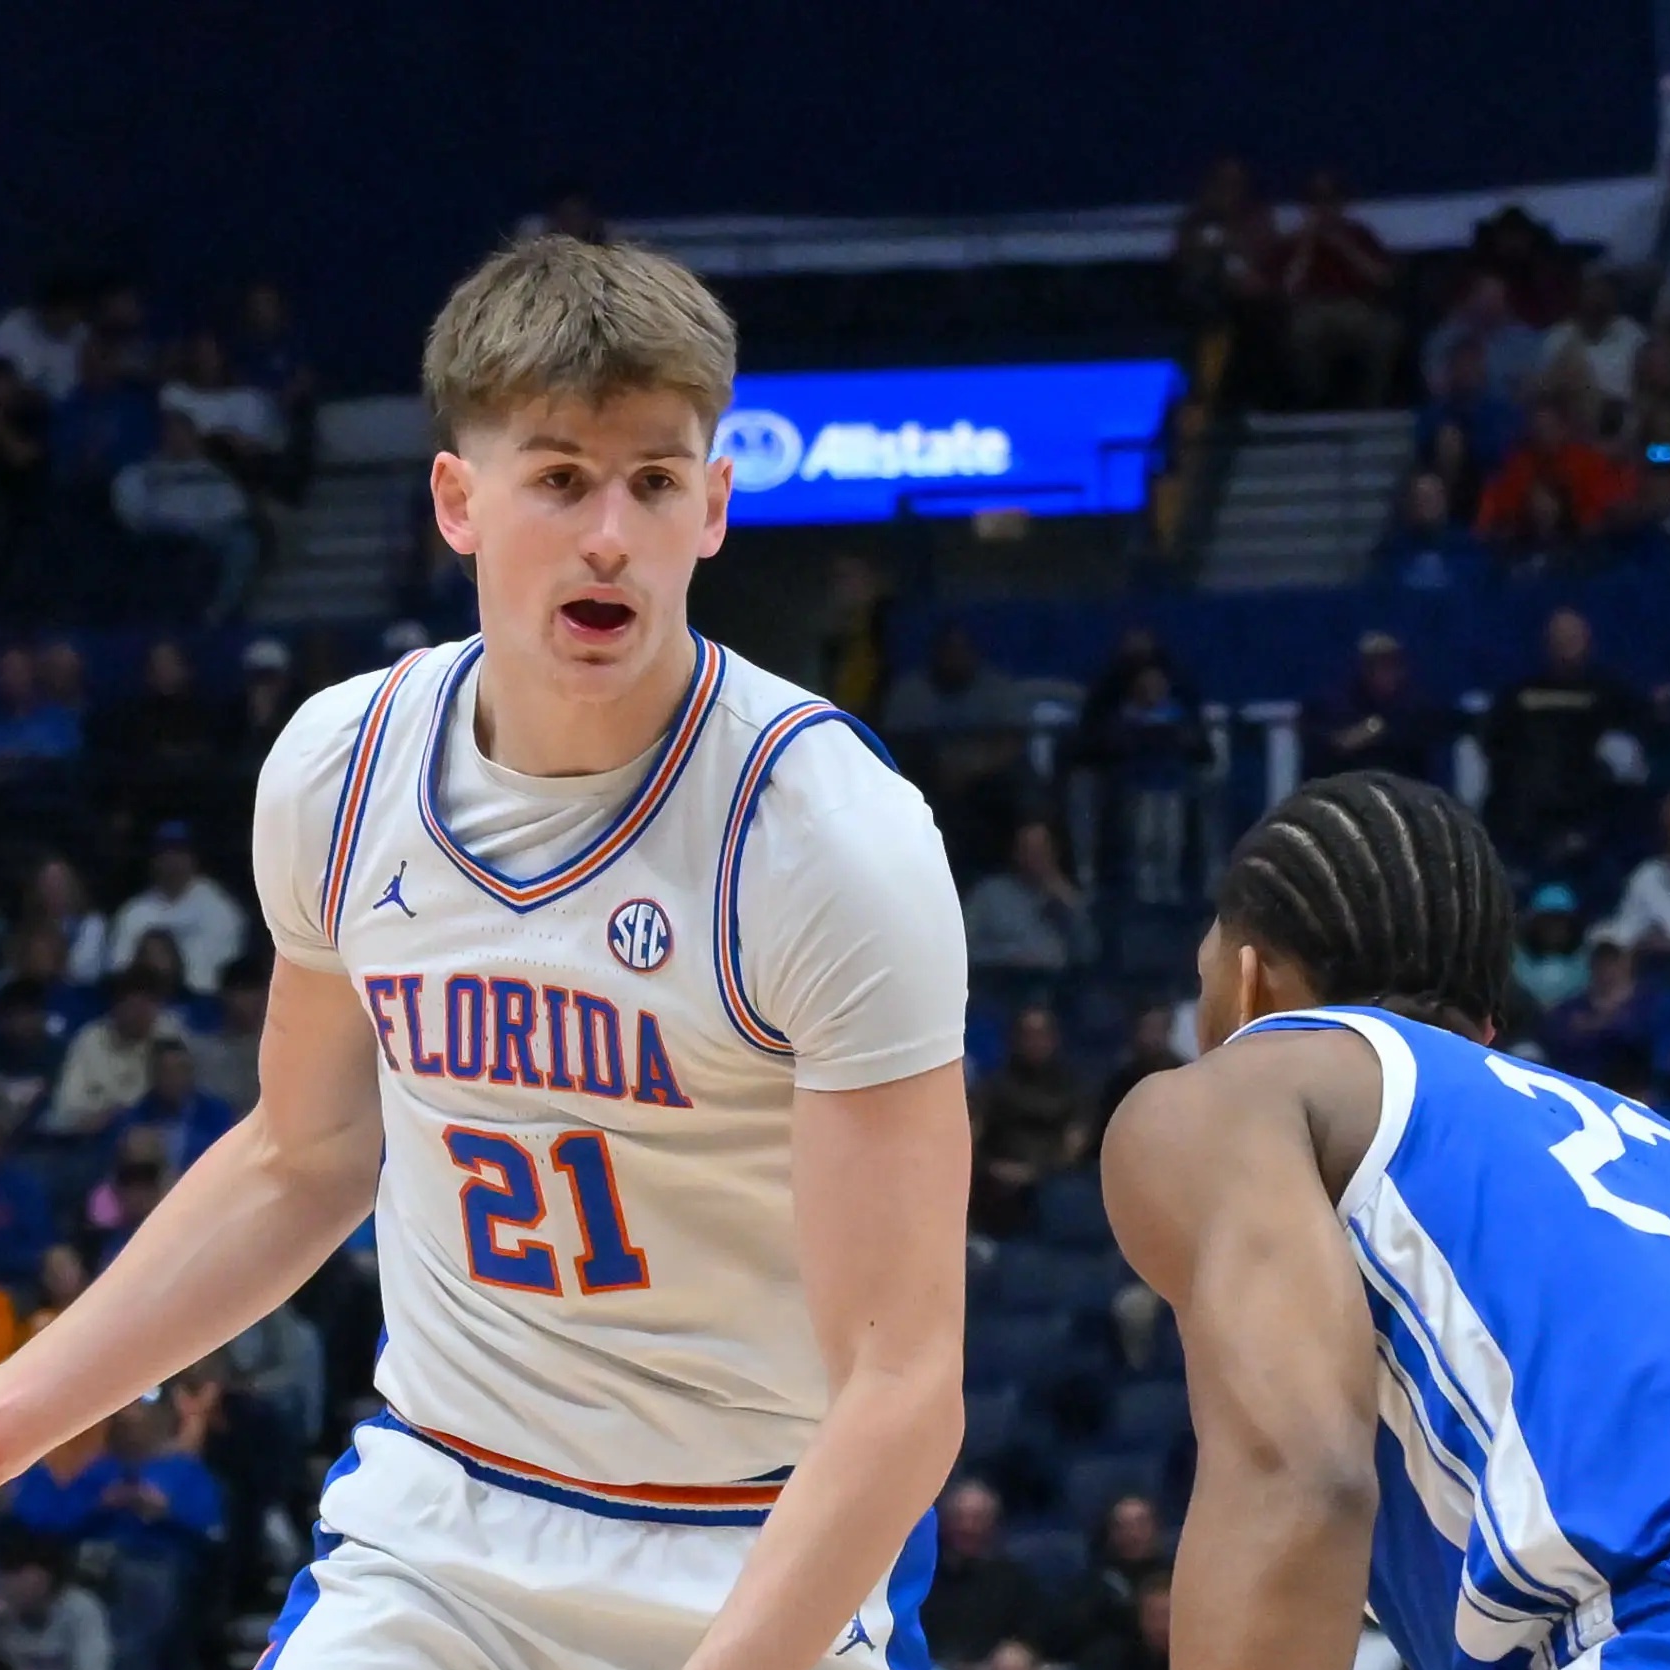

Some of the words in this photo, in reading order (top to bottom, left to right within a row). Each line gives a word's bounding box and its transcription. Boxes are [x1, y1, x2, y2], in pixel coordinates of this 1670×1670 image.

[612, 903, 667, 969] SEC
[365, 973, 694, 1108] FLORIDA
[442, 1123, 651, 1298] 21
